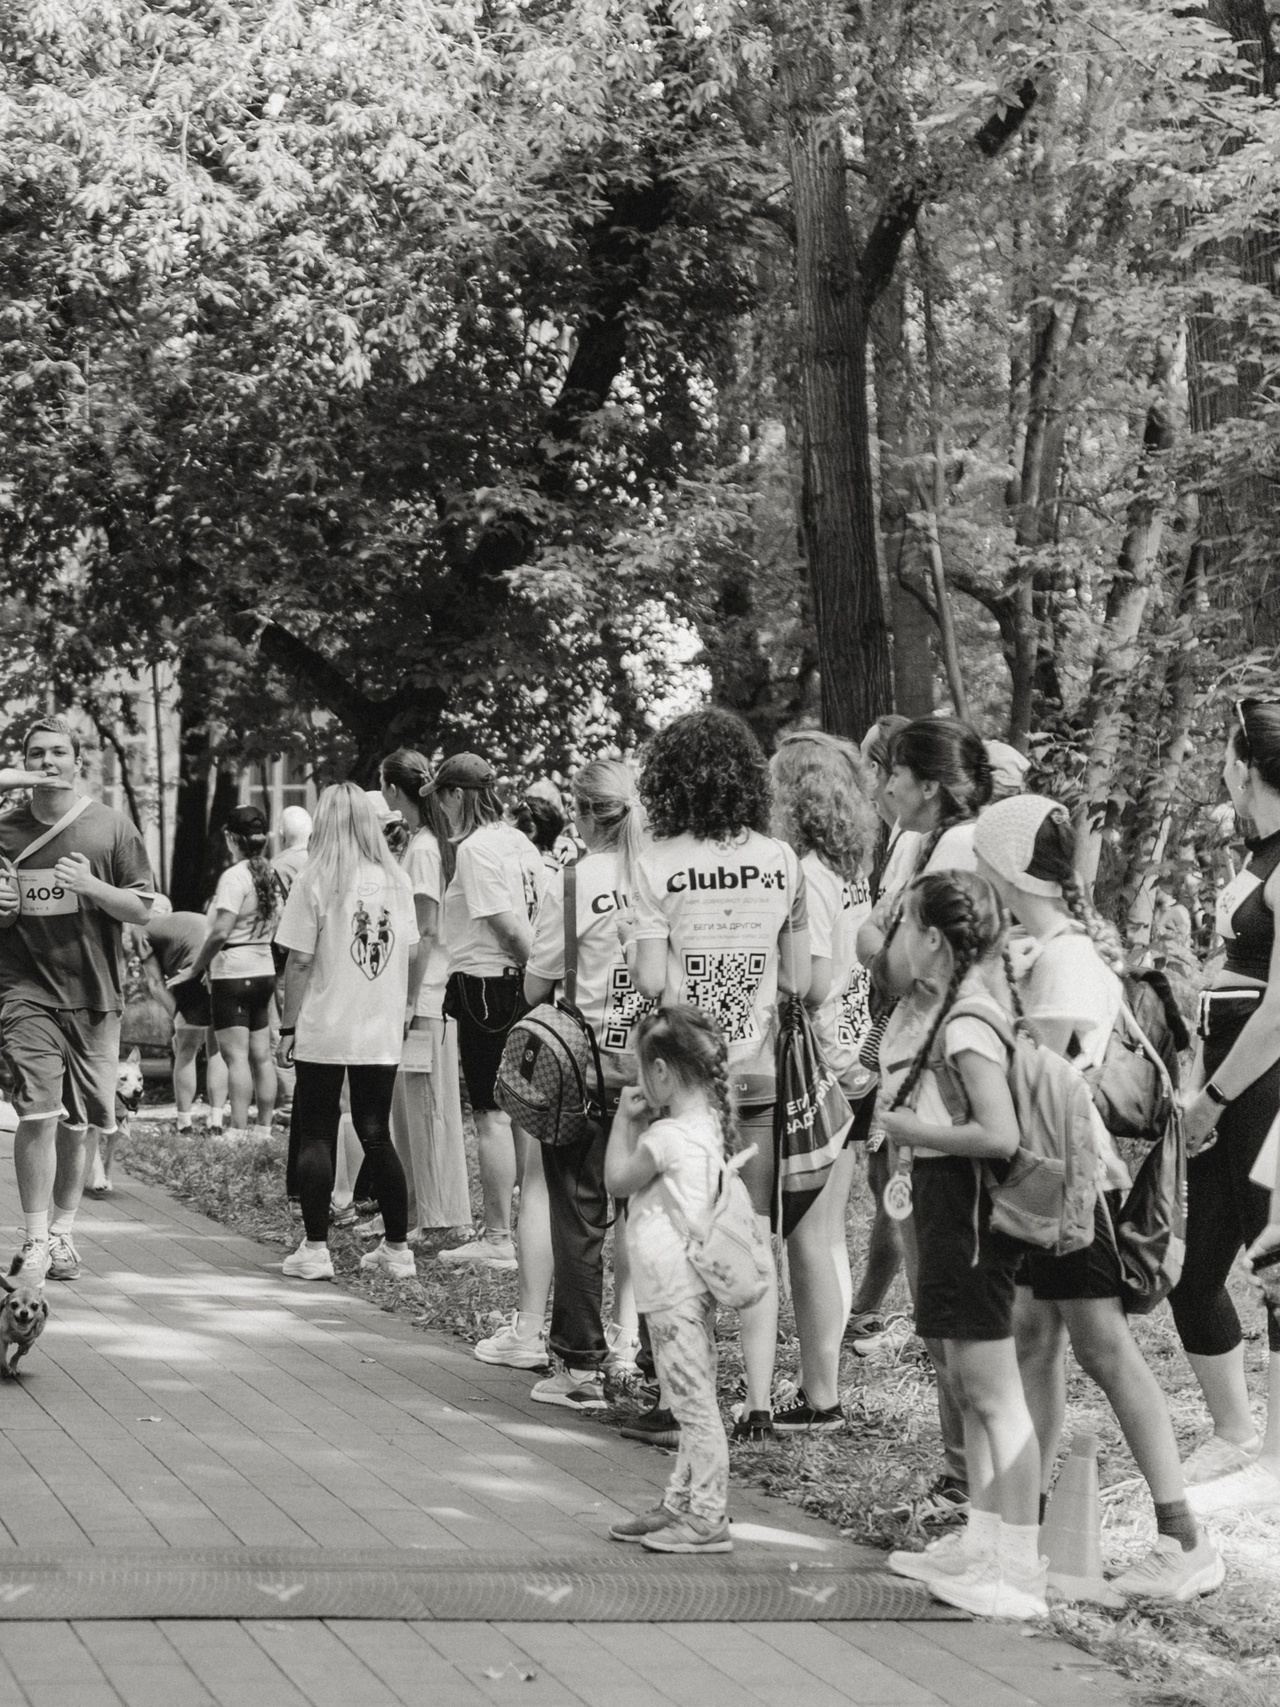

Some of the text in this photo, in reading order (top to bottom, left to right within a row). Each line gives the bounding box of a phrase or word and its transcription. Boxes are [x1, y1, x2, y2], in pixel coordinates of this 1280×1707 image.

[26, 886, 65, 901] 409
[693, 923, 714, 931] БЕГИ
[729, 921, 762, 930] ДРУГОМ
